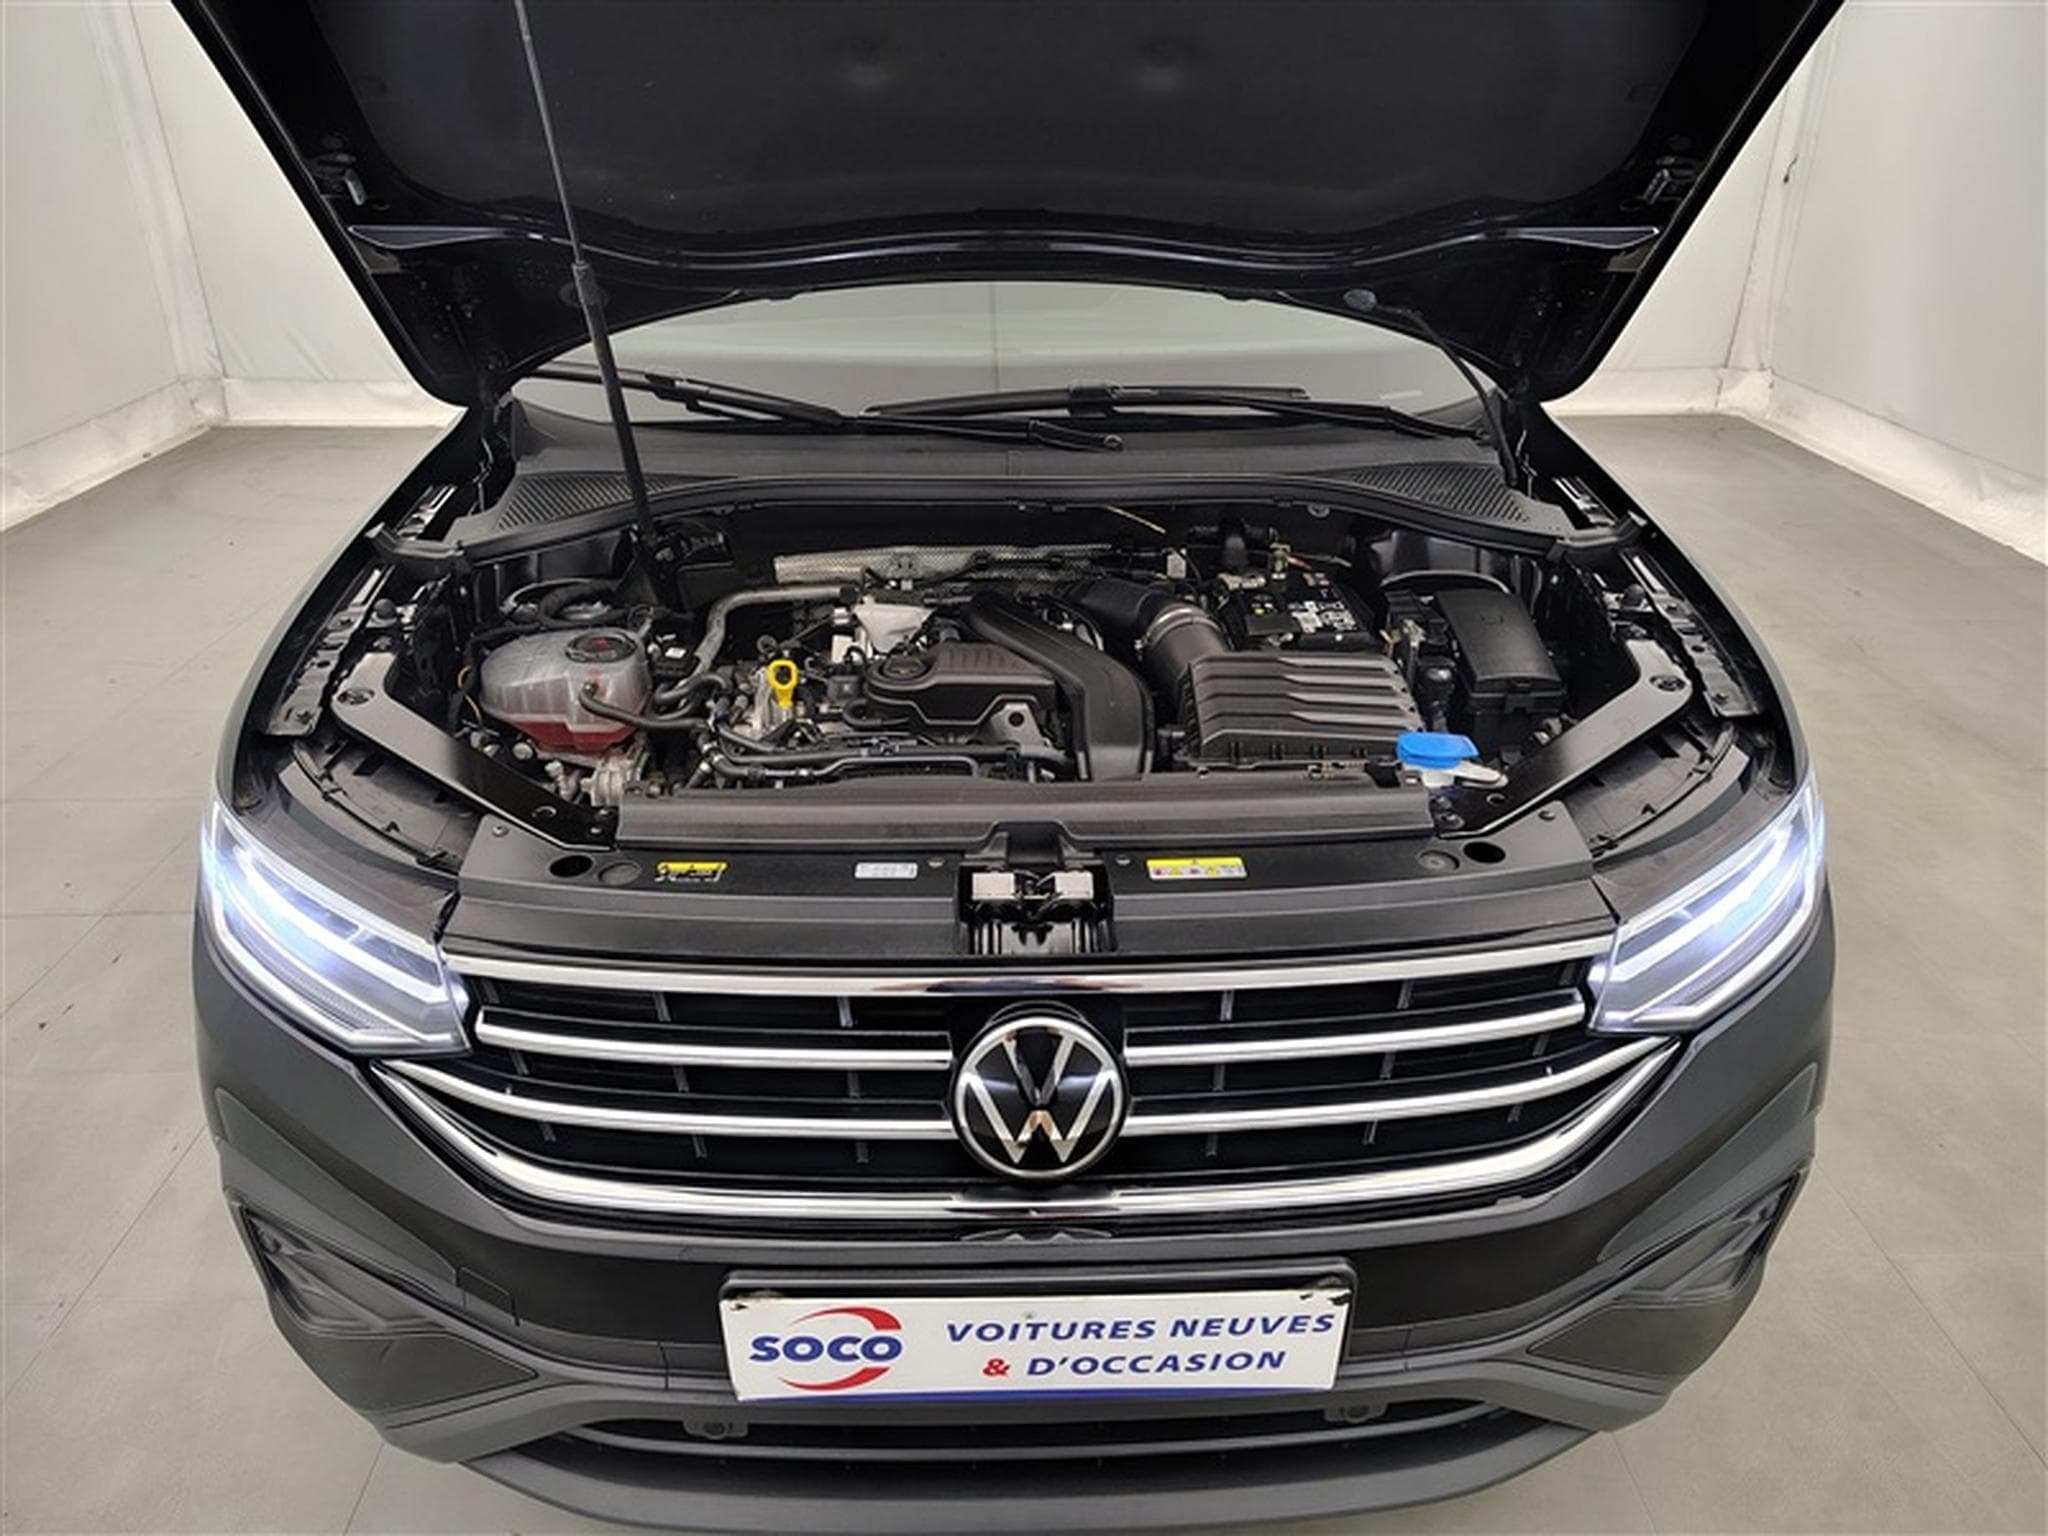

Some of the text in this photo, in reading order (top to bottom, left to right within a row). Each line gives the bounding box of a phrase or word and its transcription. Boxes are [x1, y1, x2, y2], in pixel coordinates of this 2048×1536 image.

[946, 1313, 1336, 1343] VOITURES NEUVES
[749, 1335, 903, 1363] SOCO
[982, 1350, 1287, 1378] & D'OCCASION
